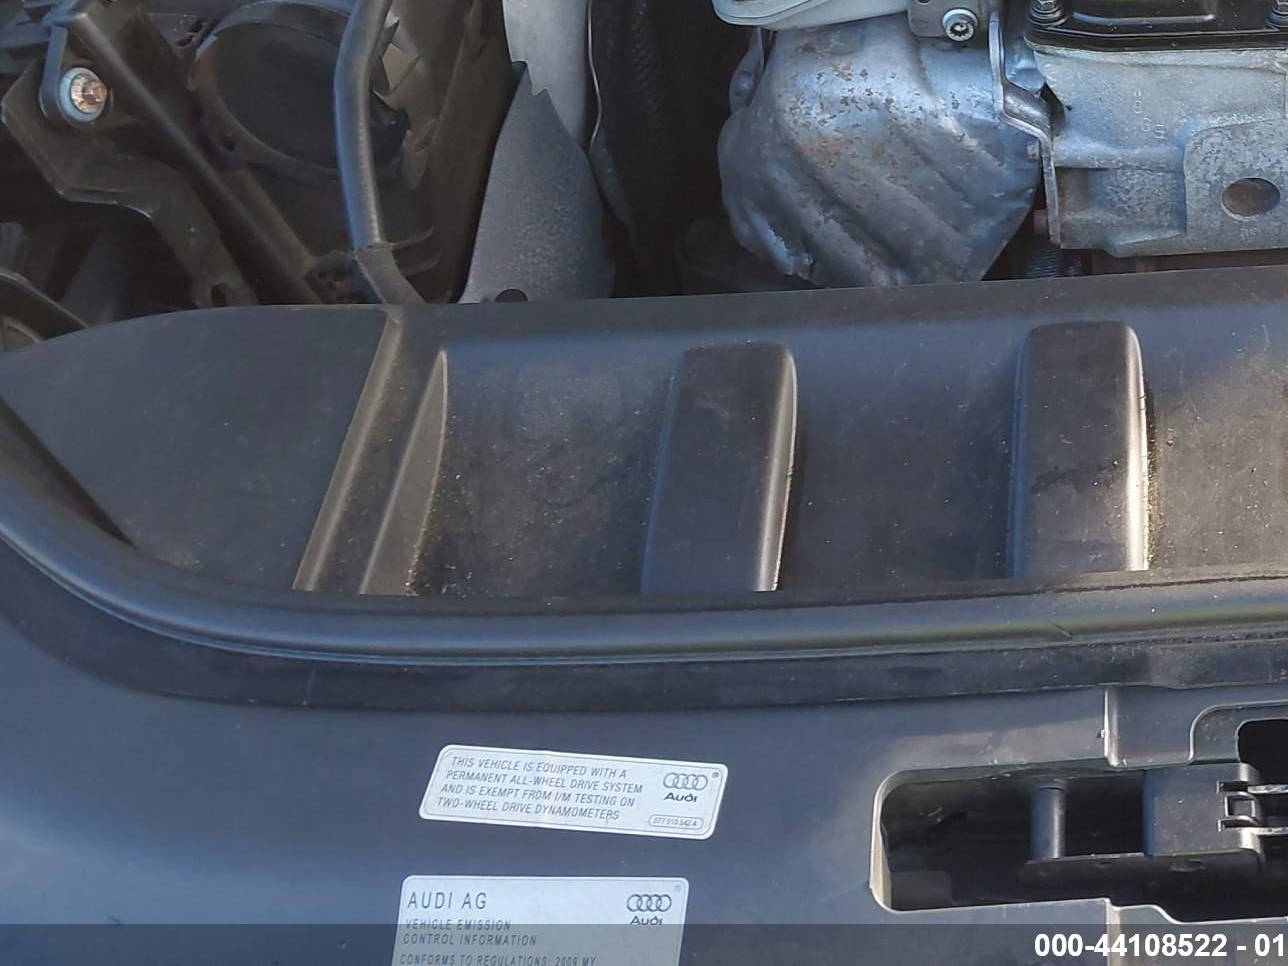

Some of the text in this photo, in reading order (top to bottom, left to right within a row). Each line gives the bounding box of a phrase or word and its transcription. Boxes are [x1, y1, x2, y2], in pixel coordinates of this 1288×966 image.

[452, 756, 627, 779] THIS VEHICLE IS EQUIPPED WITH A
[446, 770, 643, 794] PERMANENT ALL-WHEEL DRIVE SYSTEM
[440, 784, 463, 794] AND
[465, 786, 476, 795] IS
[478, 786, 520, 798] EXEMPT
[522, 789, 551, 800] FROM
[574, 793, 616, 805] TESTING
[619, 797, 636, 807] ON
[664, 792, 698, 803] Audi
[438, 797, 620, 820] TWO-WHEEL DRIVE DYNAMOMETERS
[407, 892, 487, 910] AUDI AG
[405, 919, 511, 931] VEHICLE EMISSION
[630, 916, 663, 926] Audi
[402, 934, 537, 947] CONTROL INFORMATION
[400, 954, 455, 966] CONFORMS
[460, 955, 473, 966] TO
[582, 957, 597, 966] MY
